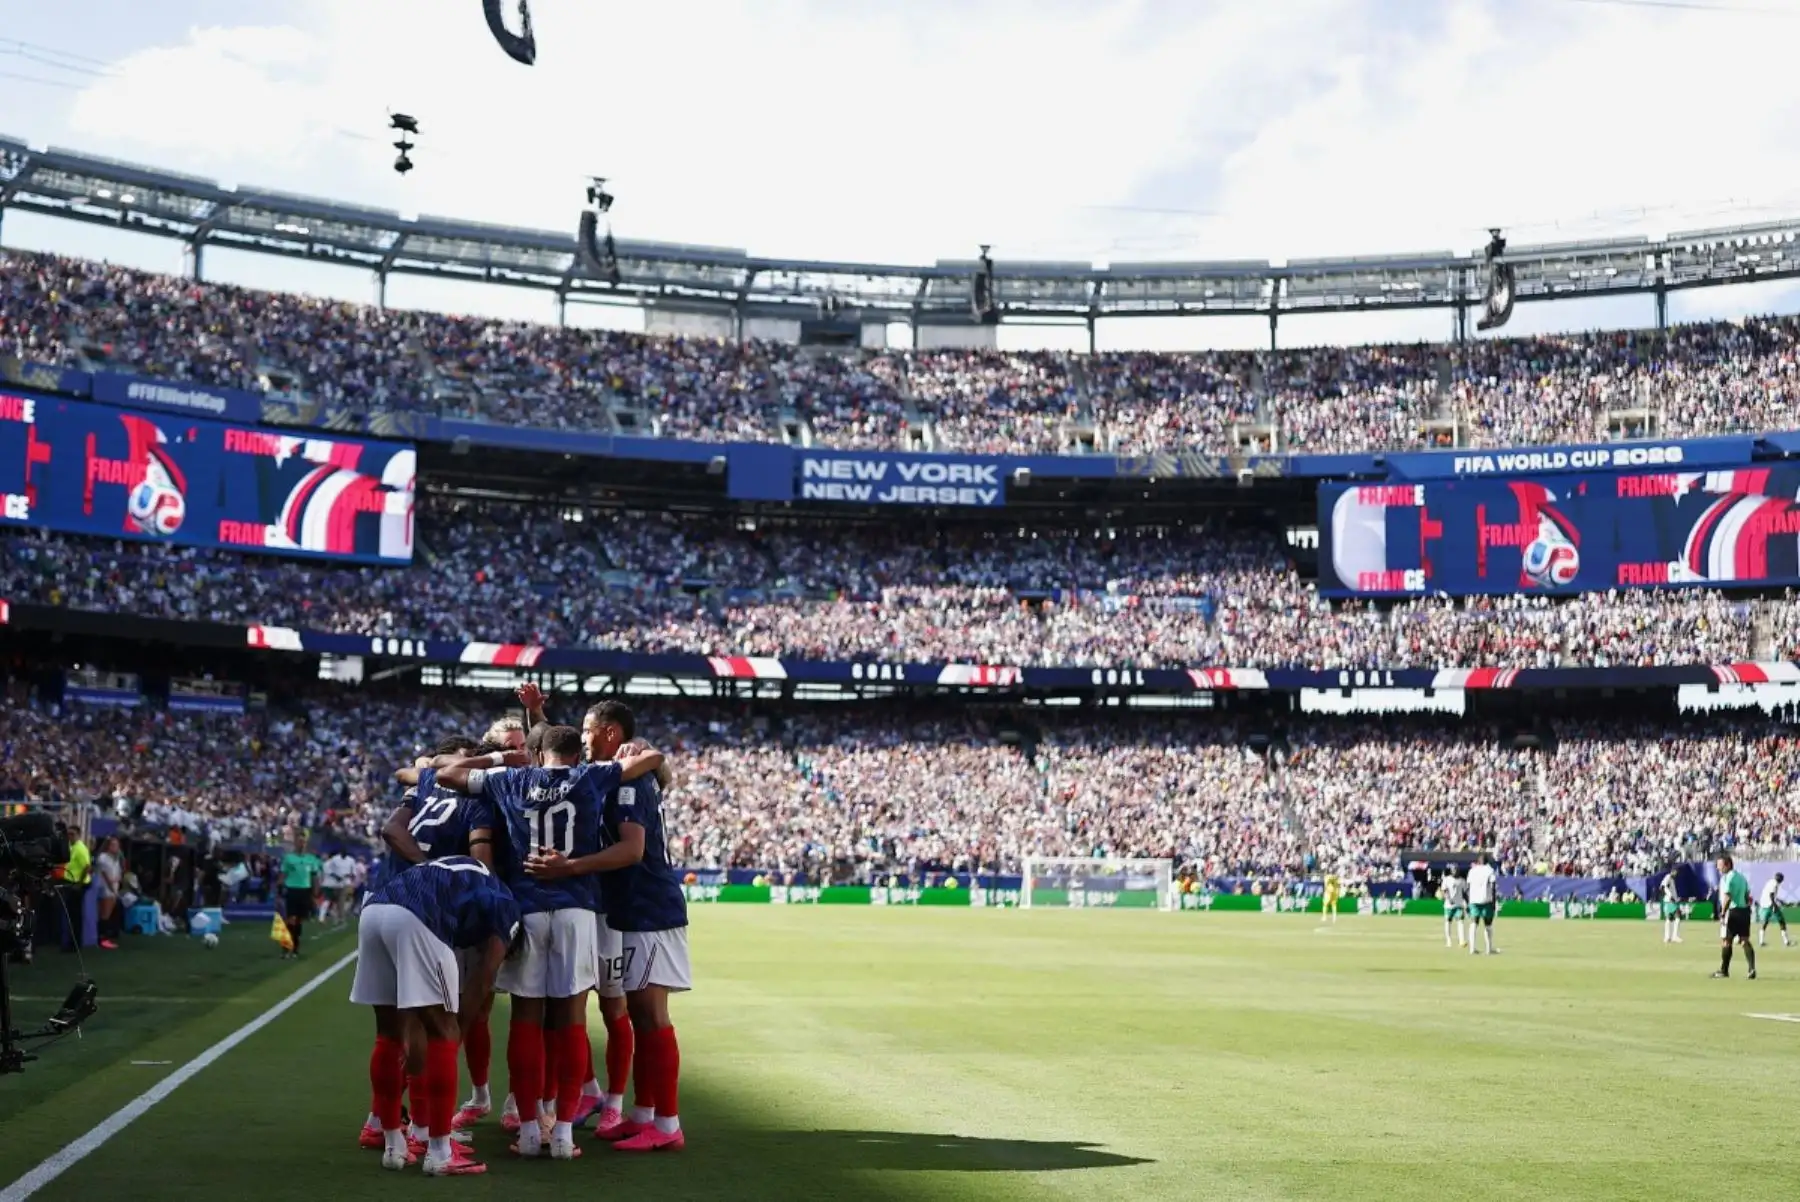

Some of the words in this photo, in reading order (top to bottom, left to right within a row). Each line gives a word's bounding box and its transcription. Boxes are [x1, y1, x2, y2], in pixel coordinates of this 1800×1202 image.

[1455, 457, 1496, 473] FIFA
[1498, 452, 1568, 470] WORLD
[1570, 450, 1610, 468] CUP
[1613, 447, 1683, 466] 2026
[803, 459, 888, 480] NEW
[896, 462, 998, 484] YORK
[803, 482, 872, 500] NEW
[879, 486, 998, 505] JERSEY
[1358, 485, 1424, 505] FRANCE
[1480, 524, 1541, 546] FRANC
[1358, 570, 1425, 591] FRANCE
[371, 637, 426, 657] GOAL
[852, 662, 905, 680] GOAL
[1091, 669, 1145, 685] GOAL
[1338, 670, 1394, 686] GOAL
[526, 781, 575, 801] MBAPP
[407, 796, 458, 852] 12
[523, 800, 577, 858] 10
[605, 956, 625, 980] 19
